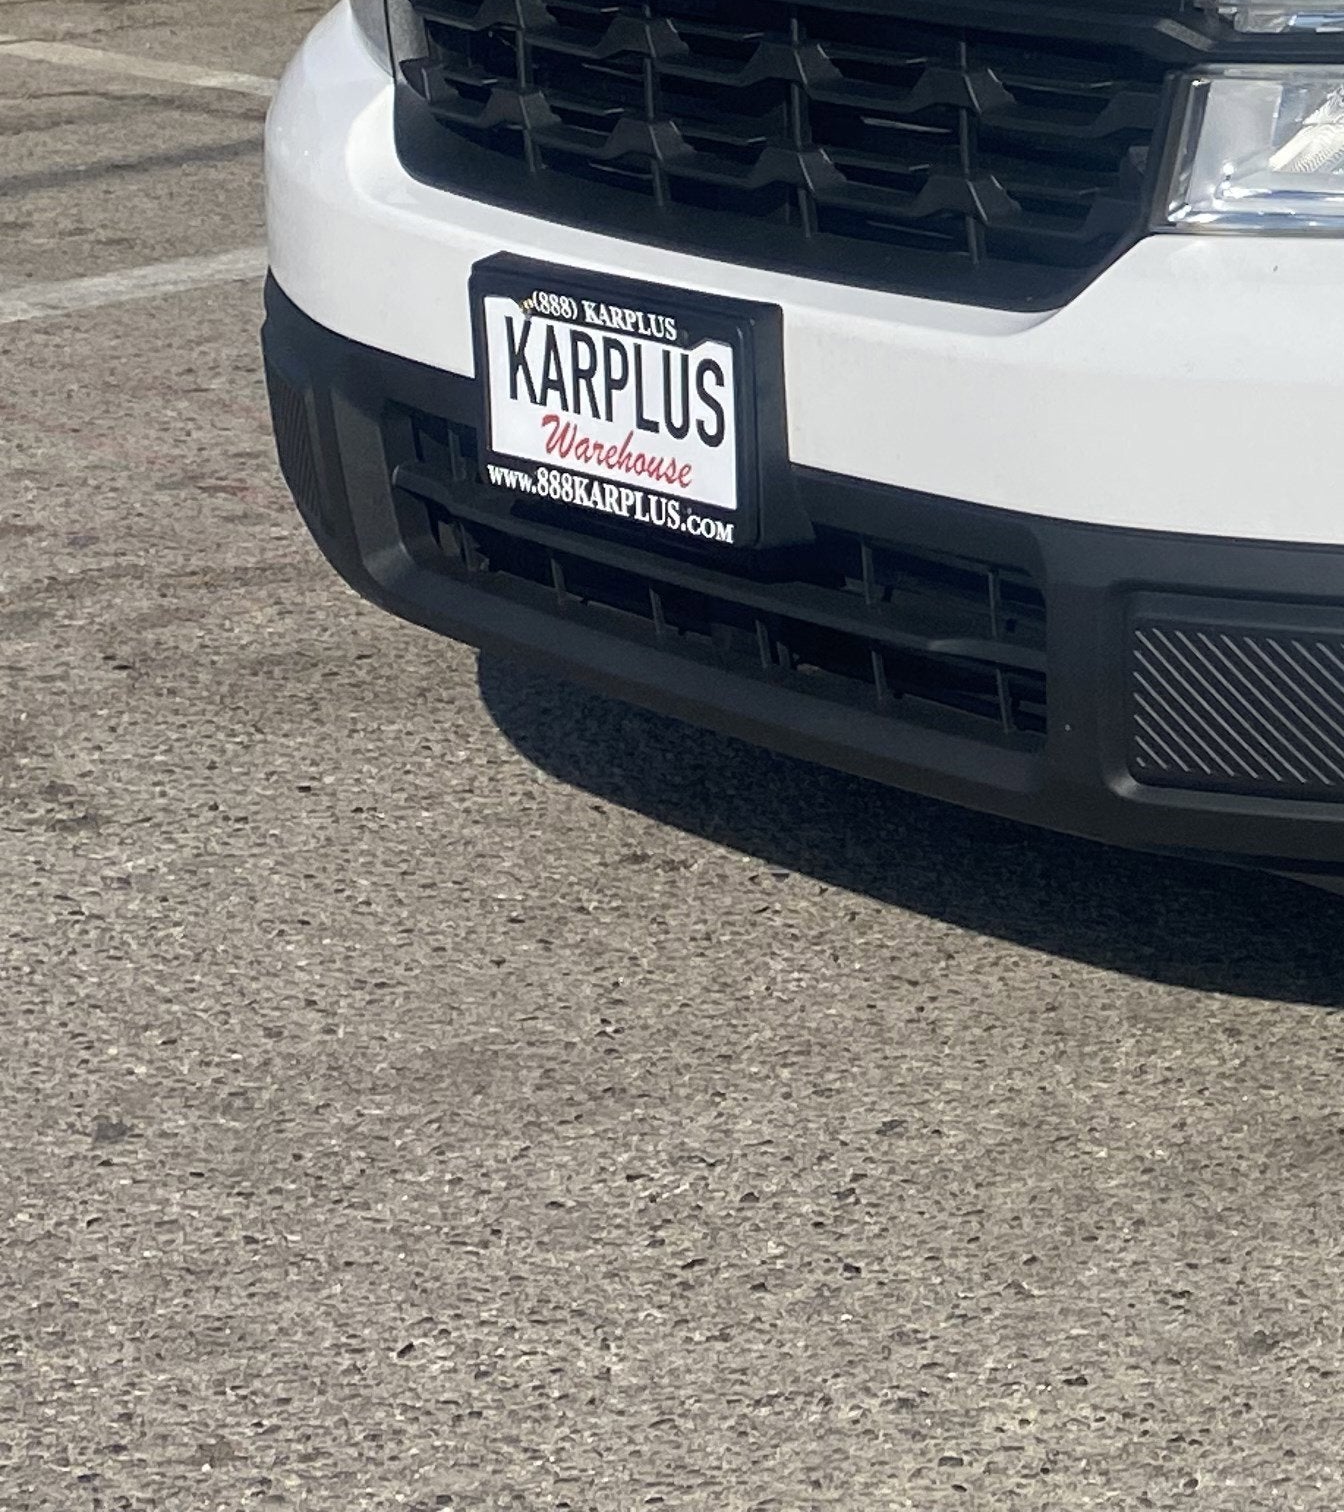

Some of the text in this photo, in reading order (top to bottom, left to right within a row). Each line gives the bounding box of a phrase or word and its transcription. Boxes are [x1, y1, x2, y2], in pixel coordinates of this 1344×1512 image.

[532, 290, 678, 340] (888) KARPLUS
[504, 314, 726, 448] KARPLUS
[541, 413, 693, 489] Warehouse
